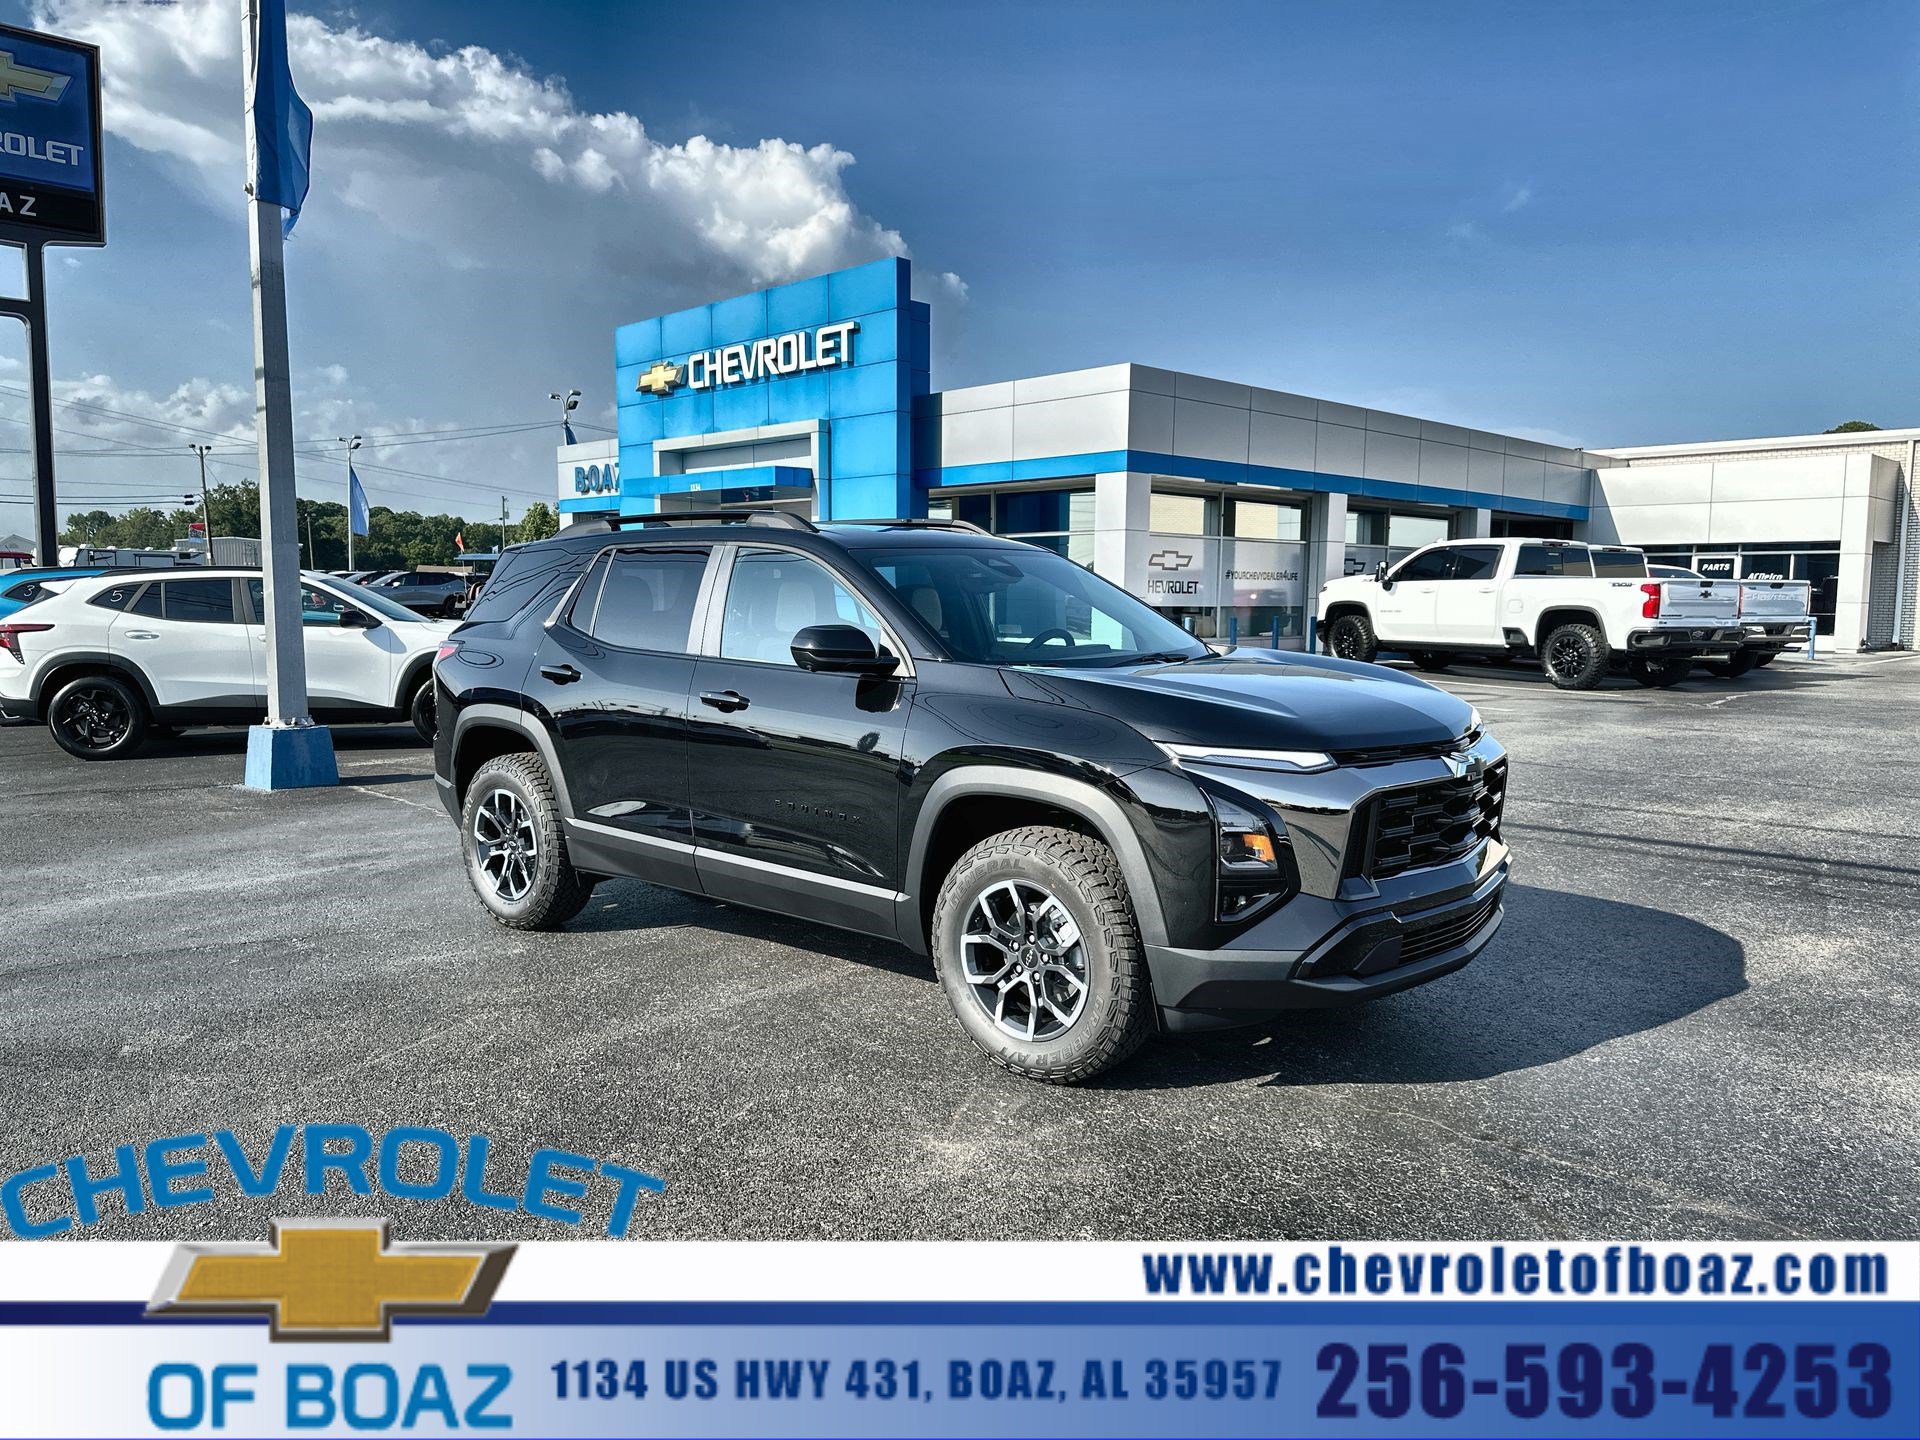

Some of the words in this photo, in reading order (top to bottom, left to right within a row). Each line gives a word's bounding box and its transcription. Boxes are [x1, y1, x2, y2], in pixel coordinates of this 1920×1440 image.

[0, 131, 84, 166] OLET
[688, 321, 857, 389] CHEVROLET
[1225, 569, 1299, 581] #YOURCHEVYDEALER4LIFE
[1701, 563, 1731, 572] PARTS
[23, 584, 35, 597] 3
[110, 589, 124, 603] 5
[949, 858, 1026, 911] GENERAL
[1036, 993, 1105, 1066] GRABBER
[996, 1046, 1031, 1065] A/T
